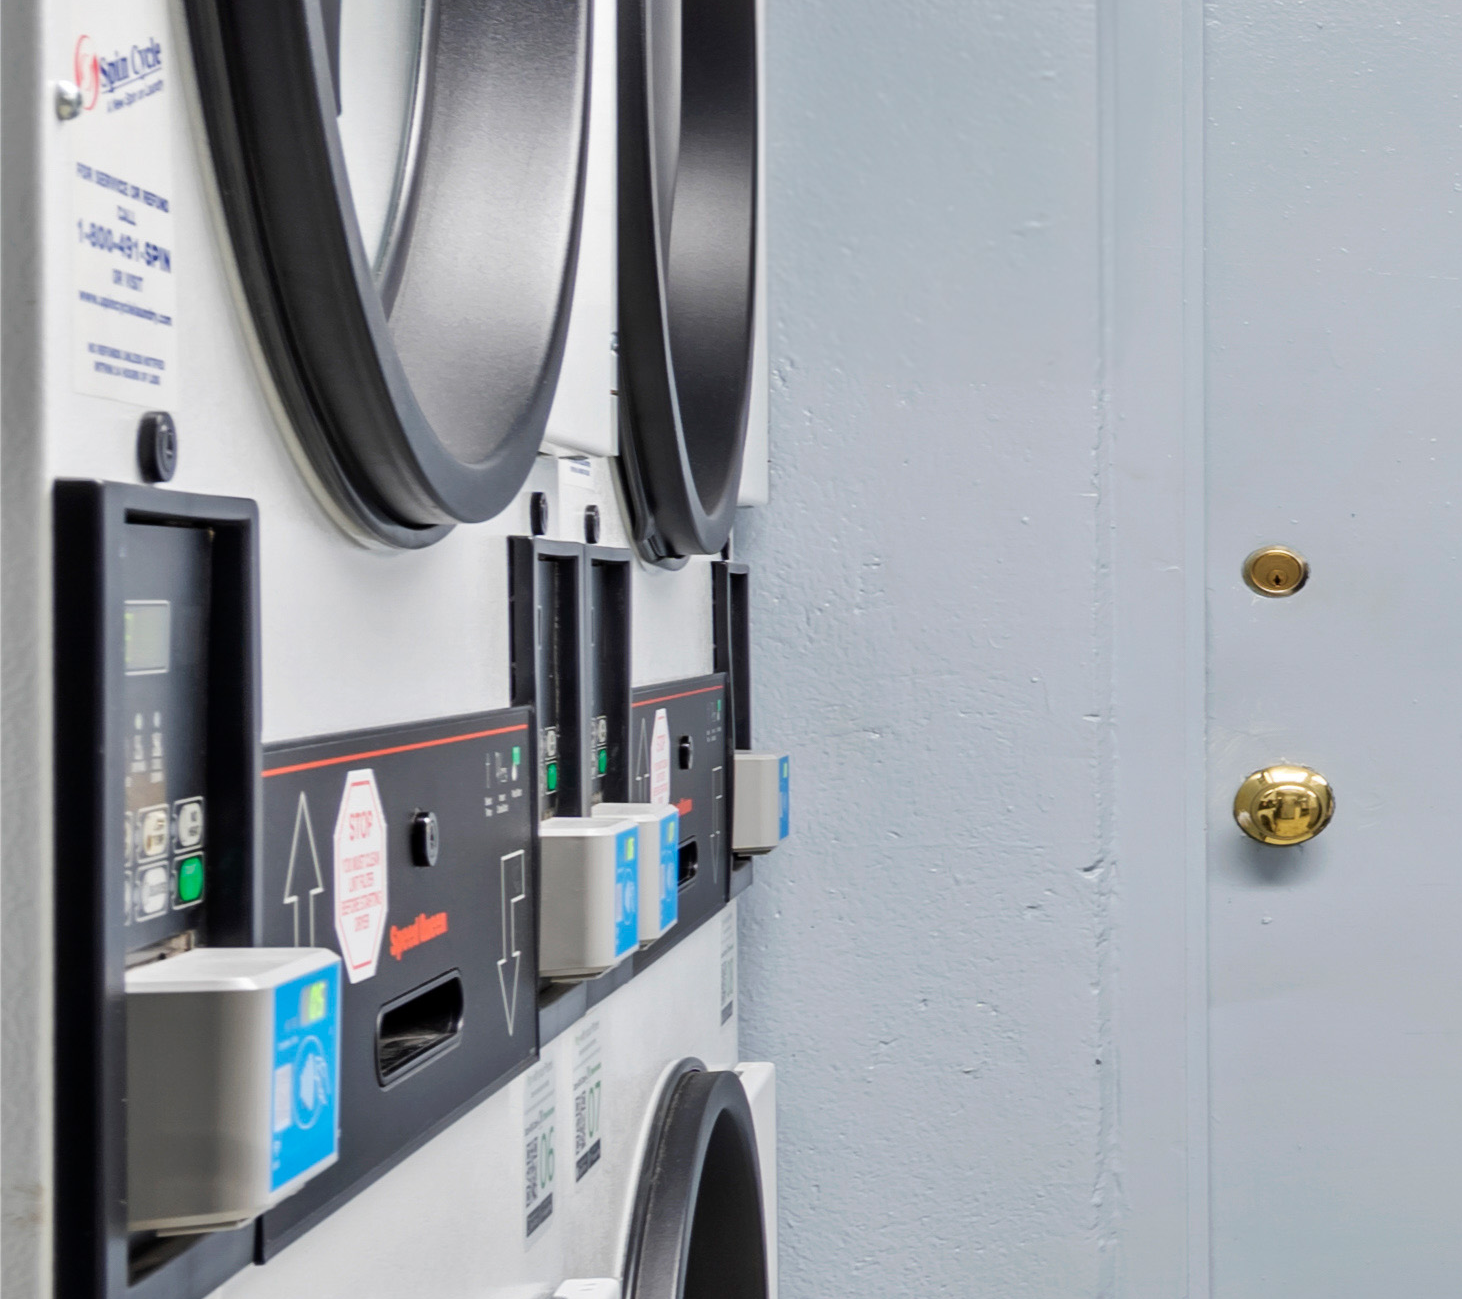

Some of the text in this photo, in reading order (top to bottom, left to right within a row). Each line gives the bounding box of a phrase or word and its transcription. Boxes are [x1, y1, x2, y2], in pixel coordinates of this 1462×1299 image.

[101, 37, 162, 93] Spin Cycle
[77, 218, 171, 273] 1-800-491-SPIN
[350, 810, 373, 841] STOP
[587, 1080, 601, 1139] 07
[540, 1125, 554, 1190] 06
